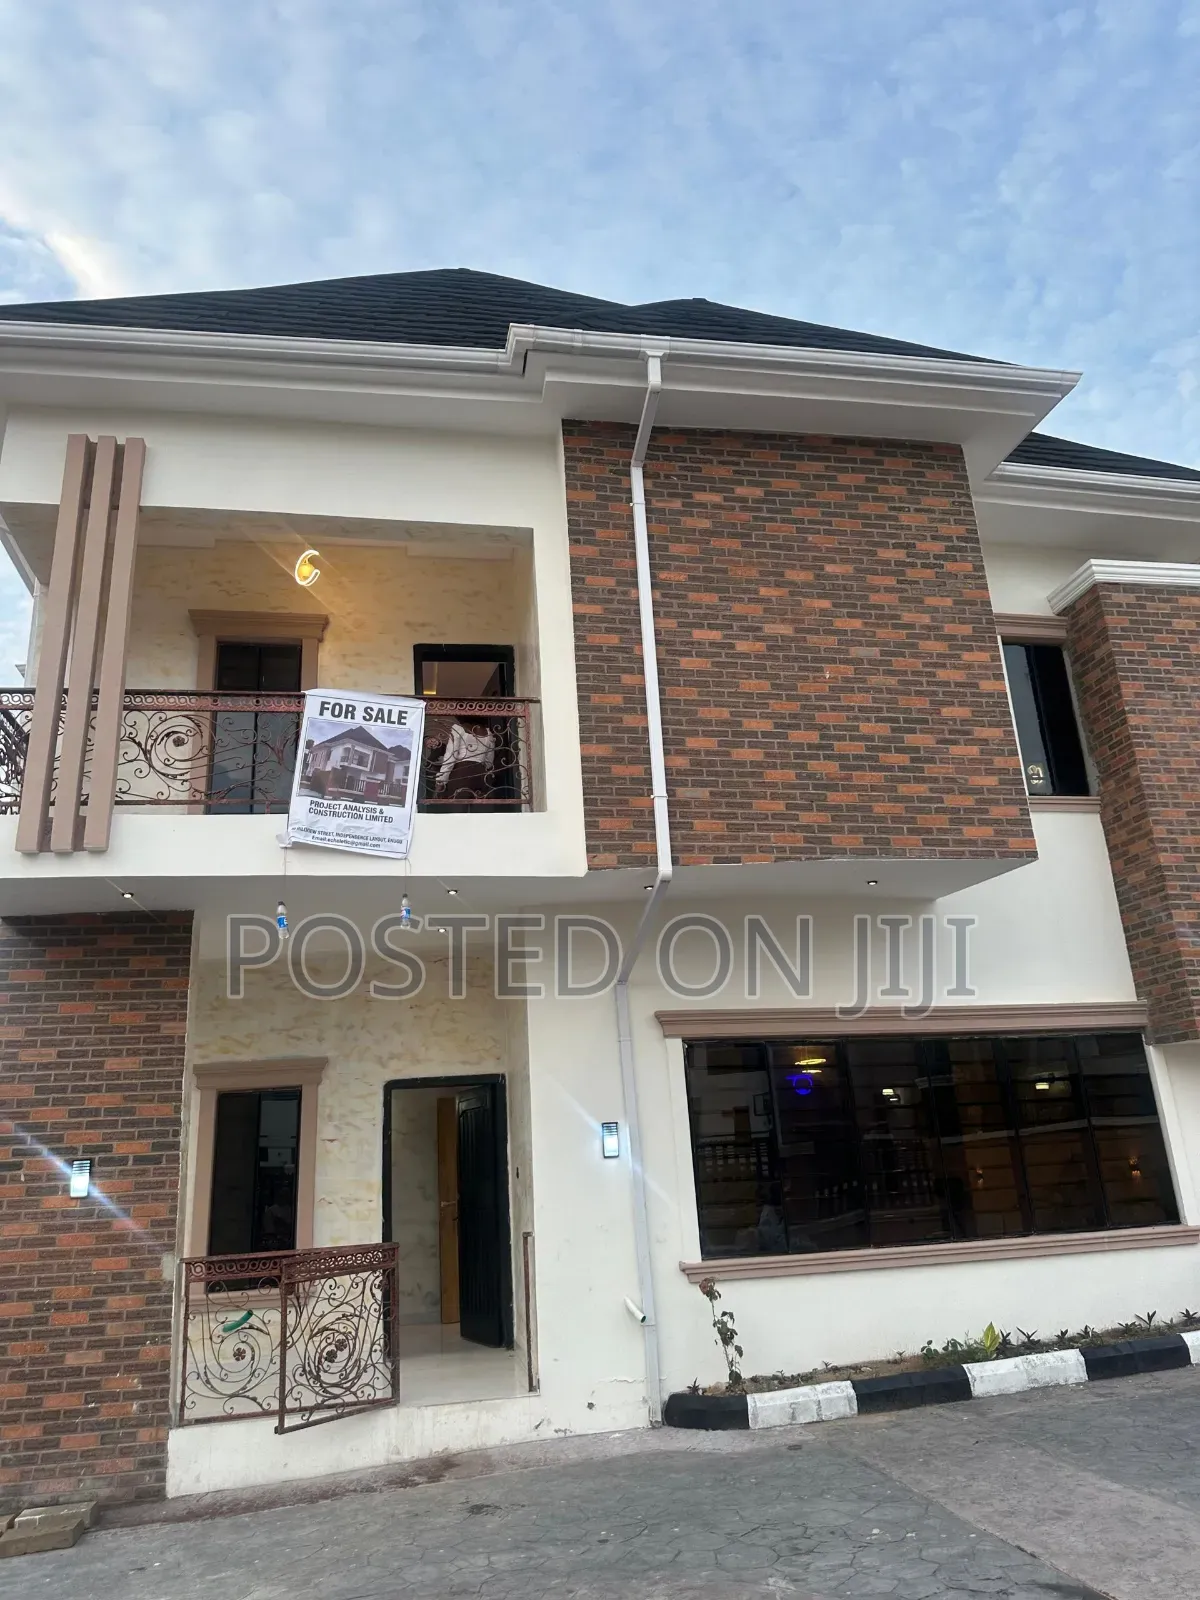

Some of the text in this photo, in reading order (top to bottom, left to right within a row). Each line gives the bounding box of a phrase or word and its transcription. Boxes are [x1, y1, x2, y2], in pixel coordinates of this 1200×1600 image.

[319, 701, 408, 725] FOR SALE
[308, 807, 394, 823] CONSTRUCTION LIMITED
[310, 800, 342, 810] PROJECT
[343, 804, 378, 814] ANALYSIS
